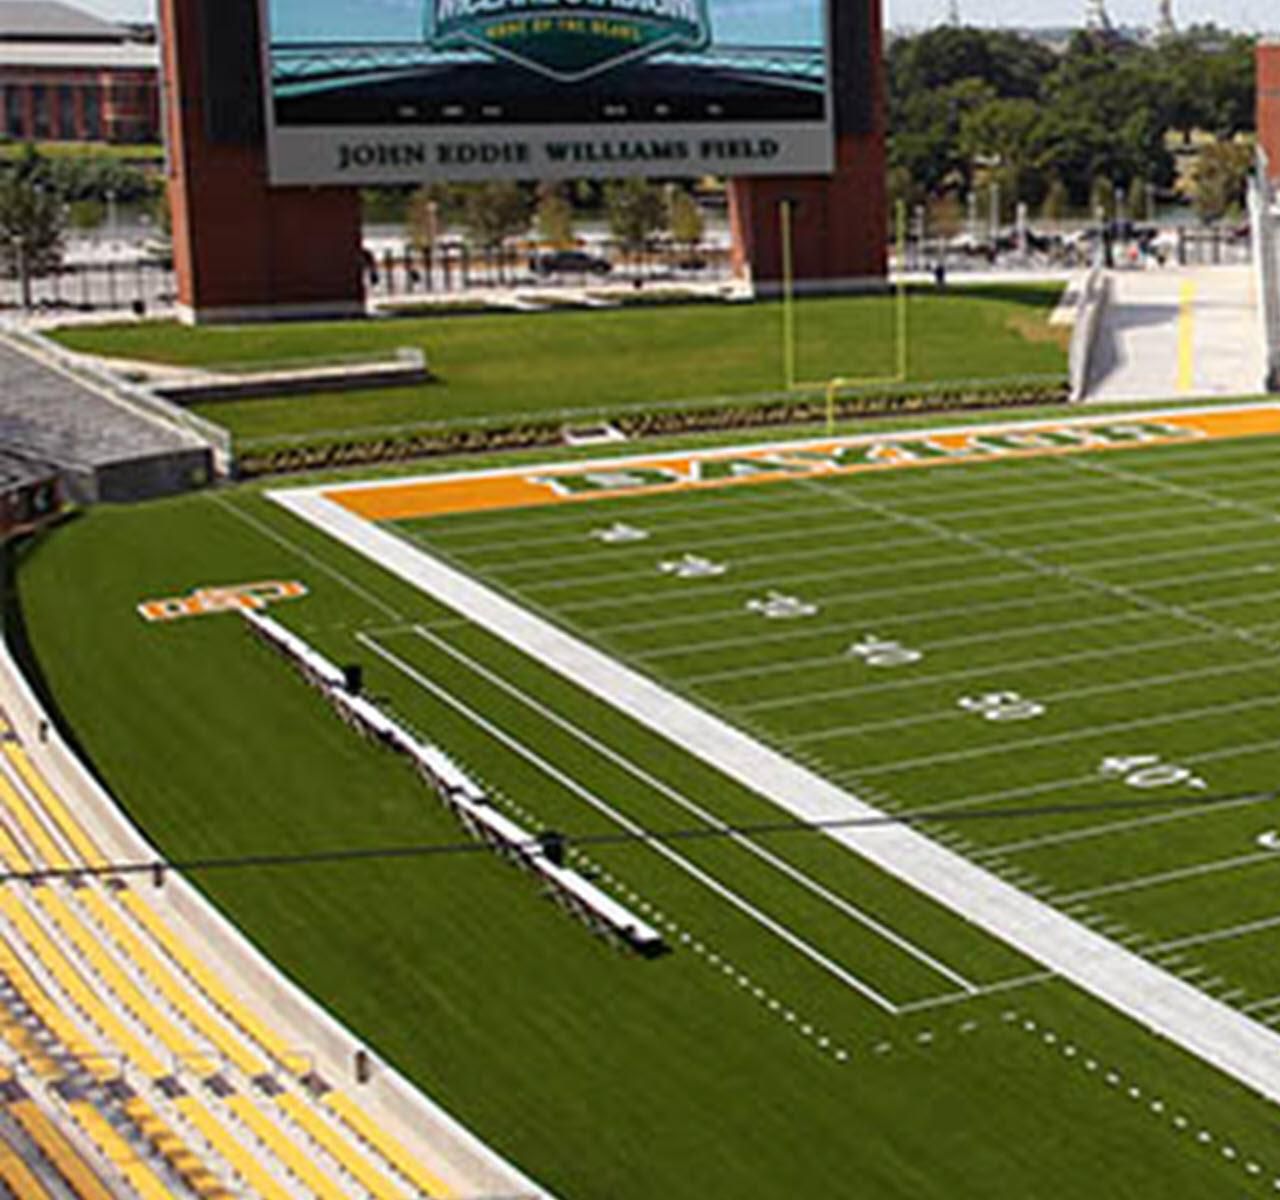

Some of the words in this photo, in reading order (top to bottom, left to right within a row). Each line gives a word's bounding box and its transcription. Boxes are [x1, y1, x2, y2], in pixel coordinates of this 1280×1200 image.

[338, 142, 426, 169] JOHN
[437, 142, 529, 165] EDDIE
[545, 138, 689, 162] WILLIAMS
[700, 136, 780, 160] FIELD
